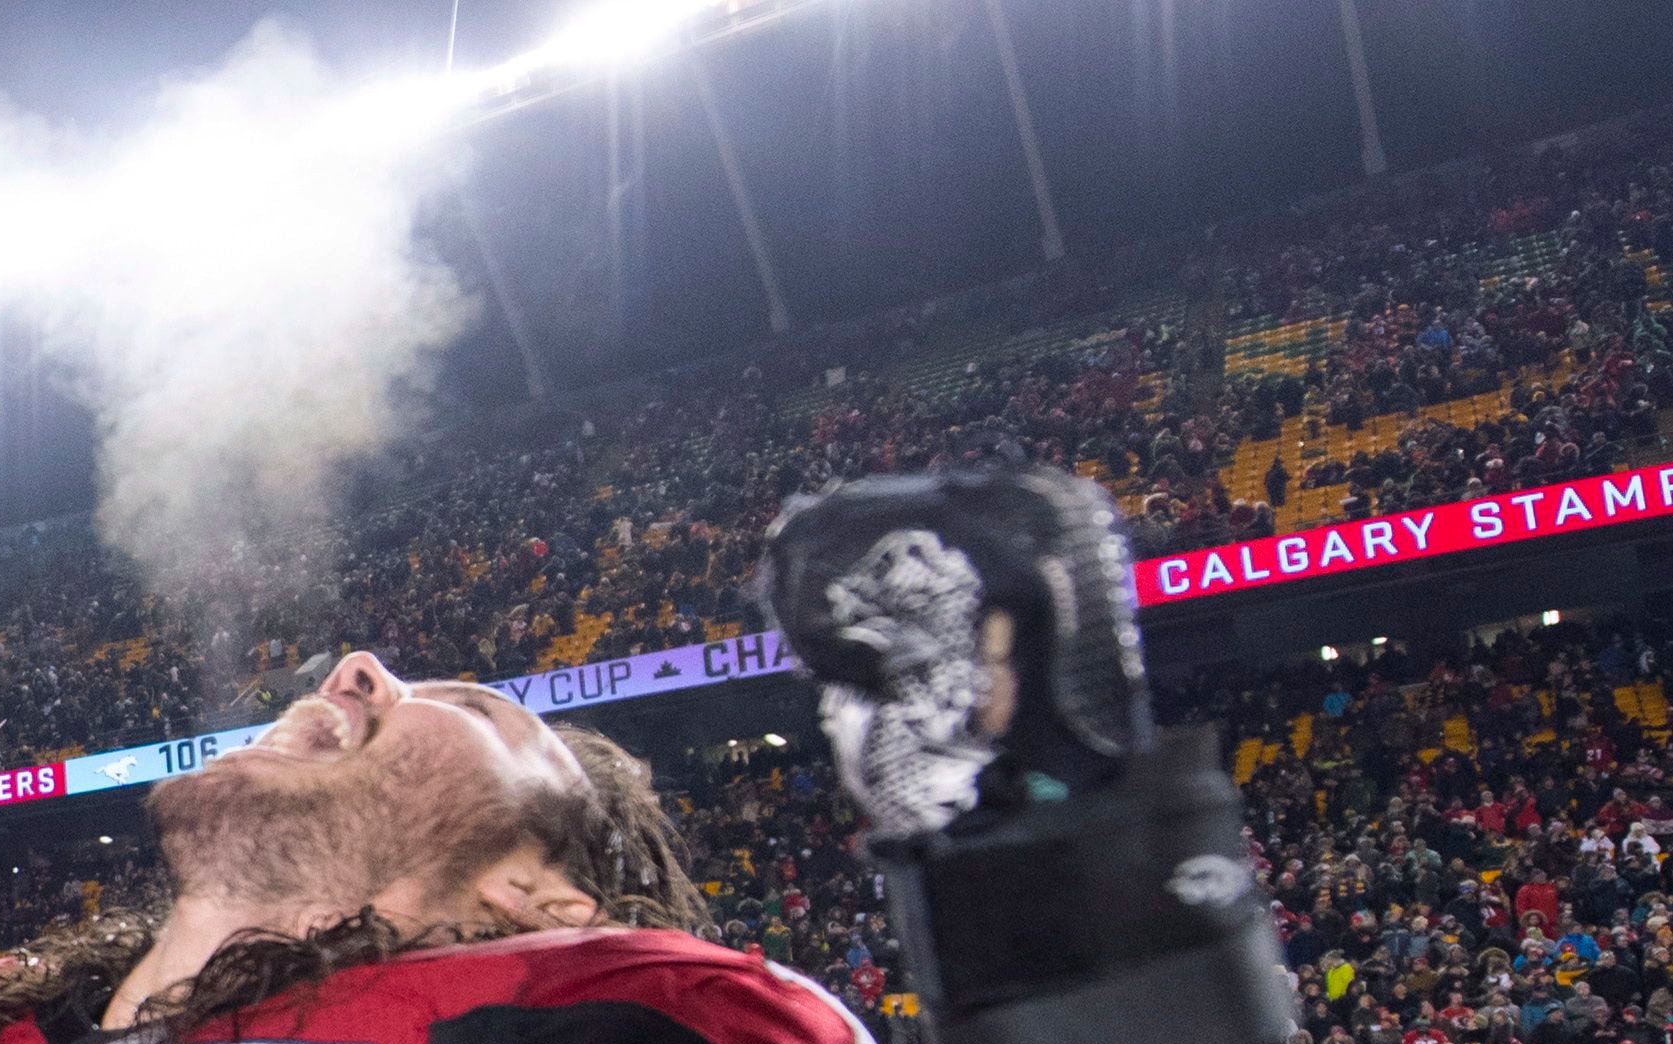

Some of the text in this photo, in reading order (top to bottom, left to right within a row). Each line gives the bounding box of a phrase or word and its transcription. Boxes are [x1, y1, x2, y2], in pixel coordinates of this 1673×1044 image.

[1159, 511, 1436, 595] CALGARY
[550, 661, 632, 705] CUP
[159, 736, 217, 773] 106
